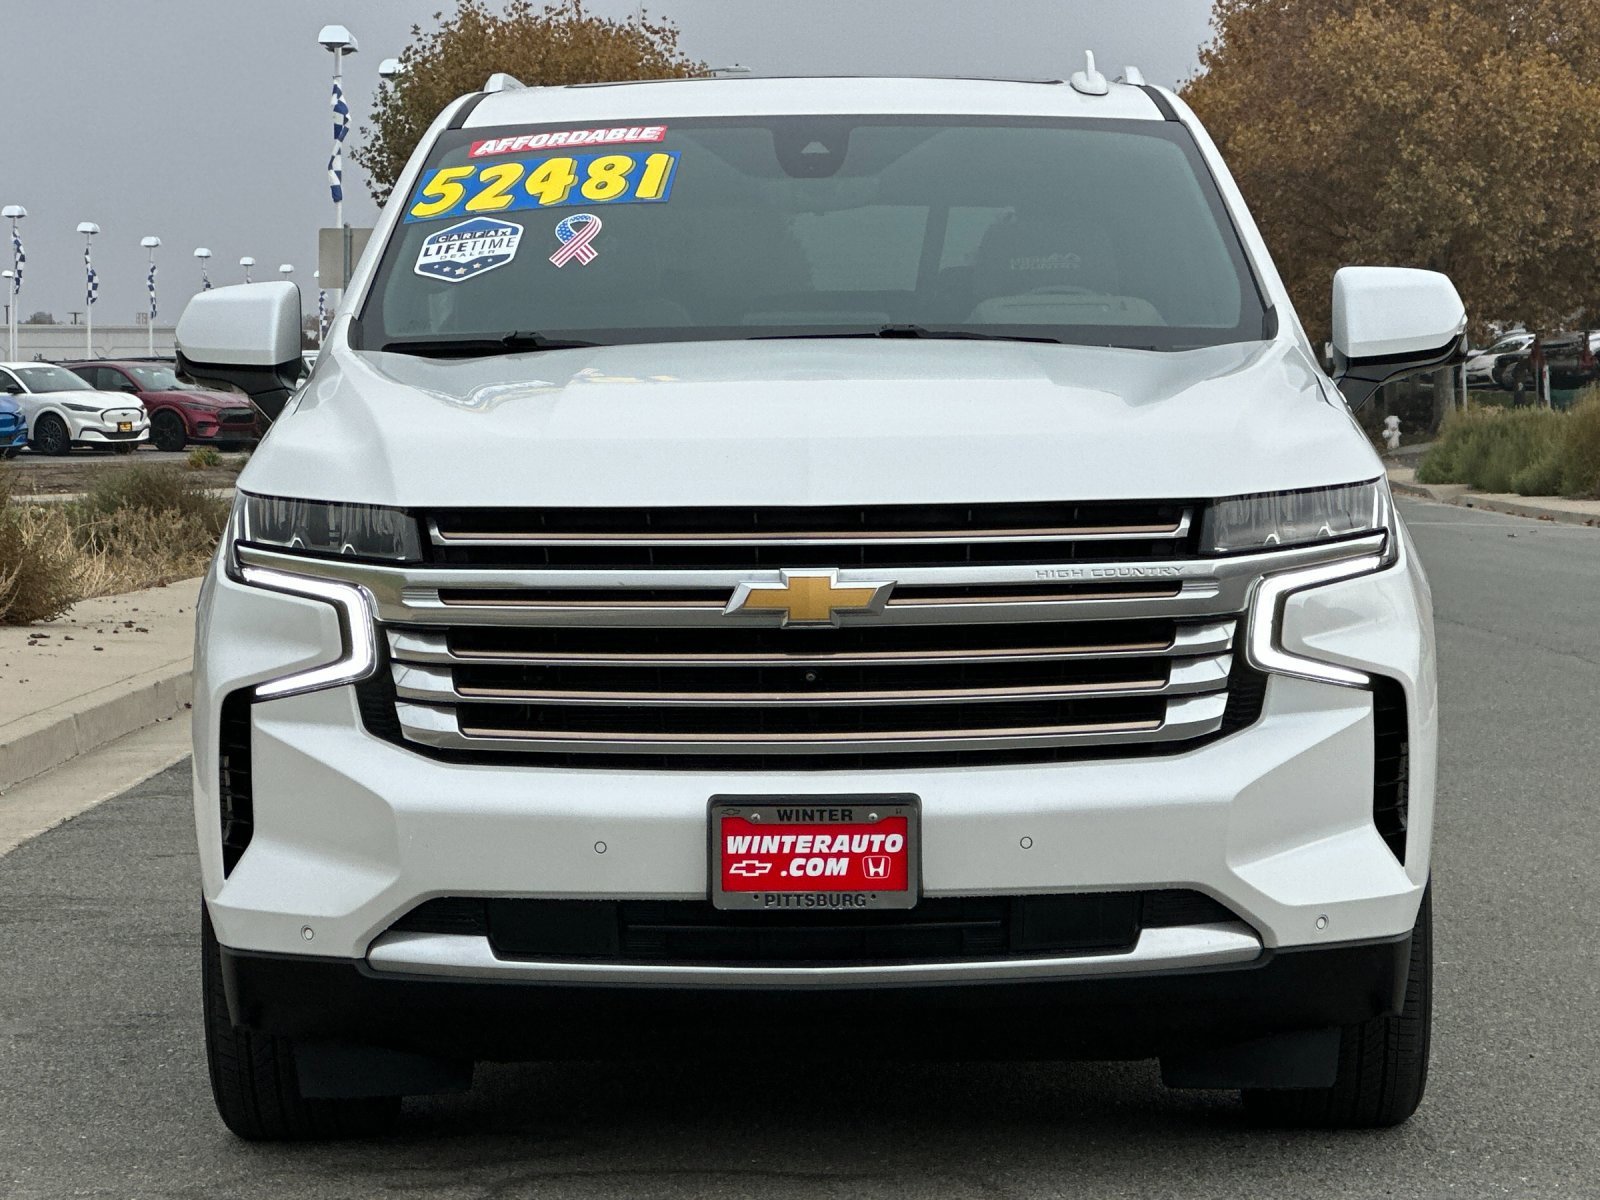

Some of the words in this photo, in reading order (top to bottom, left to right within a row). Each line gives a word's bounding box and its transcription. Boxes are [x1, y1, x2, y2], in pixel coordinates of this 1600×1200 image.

[473, 126, 665, 156] AFFORDABLE
[410, 153, 675, 217] 52481
[437, 229, 510, 243] CARFAX
[423, 237, 516, 257] LIFETIME
[440, 250, 495, 260] DEALER
[1035, 569, 1084, 579] HIGH
[1091, 566, 1185, 577] COUNTRY
[777, 809, 853, 822] WINTER
[727, 834, 904, 854] WINTERAUTO
[780, 857, 849, 877] .COM
[764, 893, 867, 908] PITTSBURG
